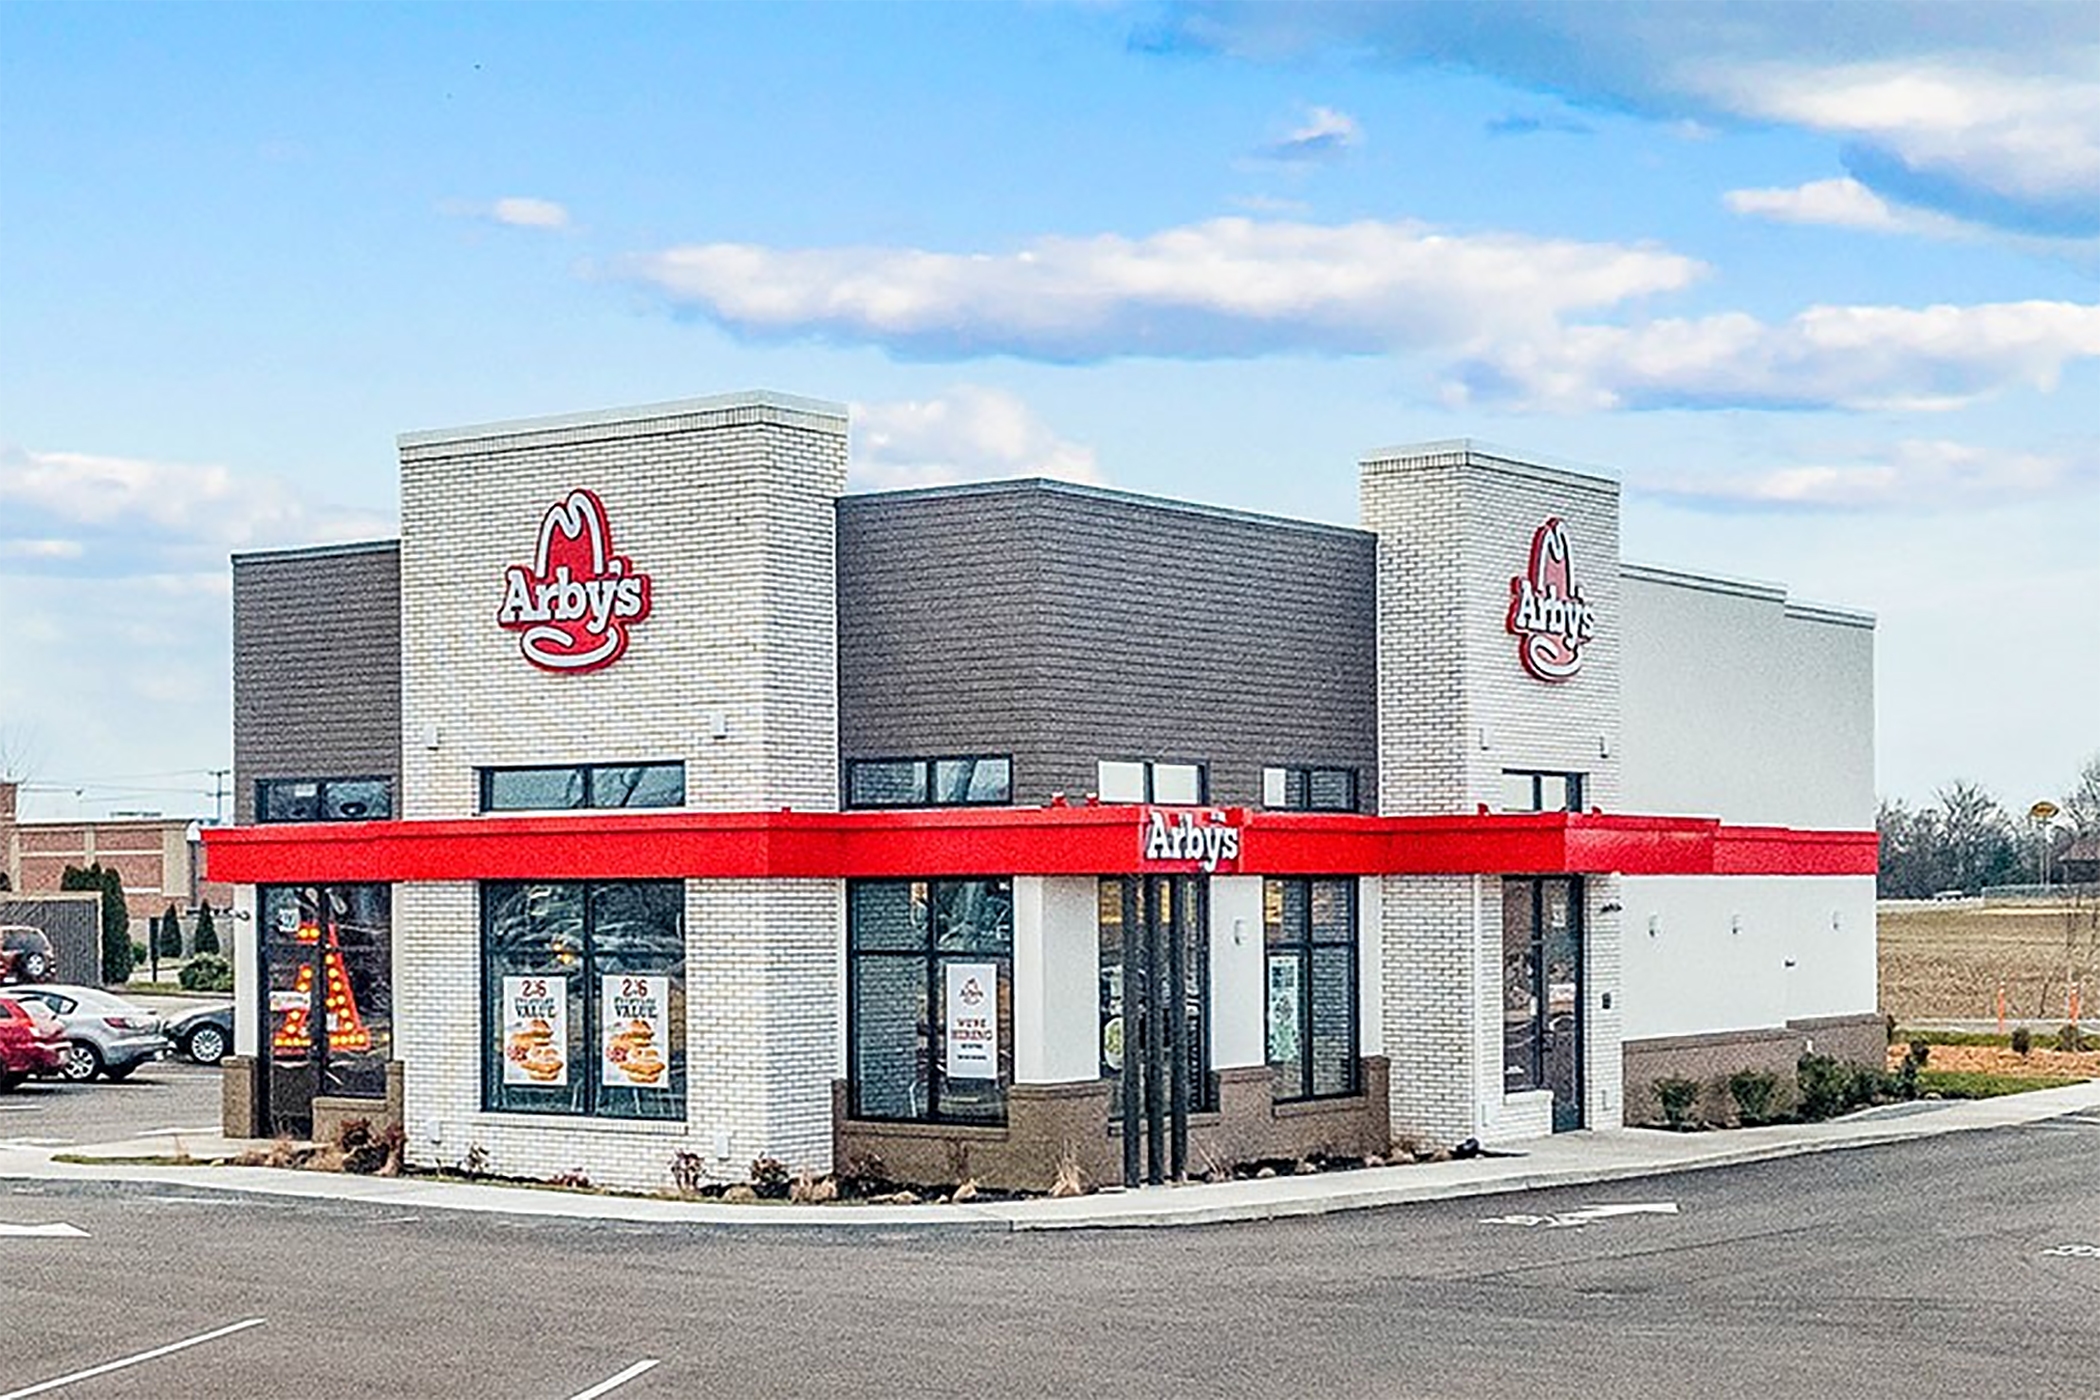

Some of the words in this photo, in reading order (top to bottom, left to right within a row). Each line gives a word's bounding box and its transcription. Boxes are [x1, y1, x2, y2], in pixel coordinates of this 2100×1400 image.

[500, 559, 642, 633] Arby's
[1516, 580, 1595, 649] Arby's
[1147, 811, 1239, 872] Arby's
